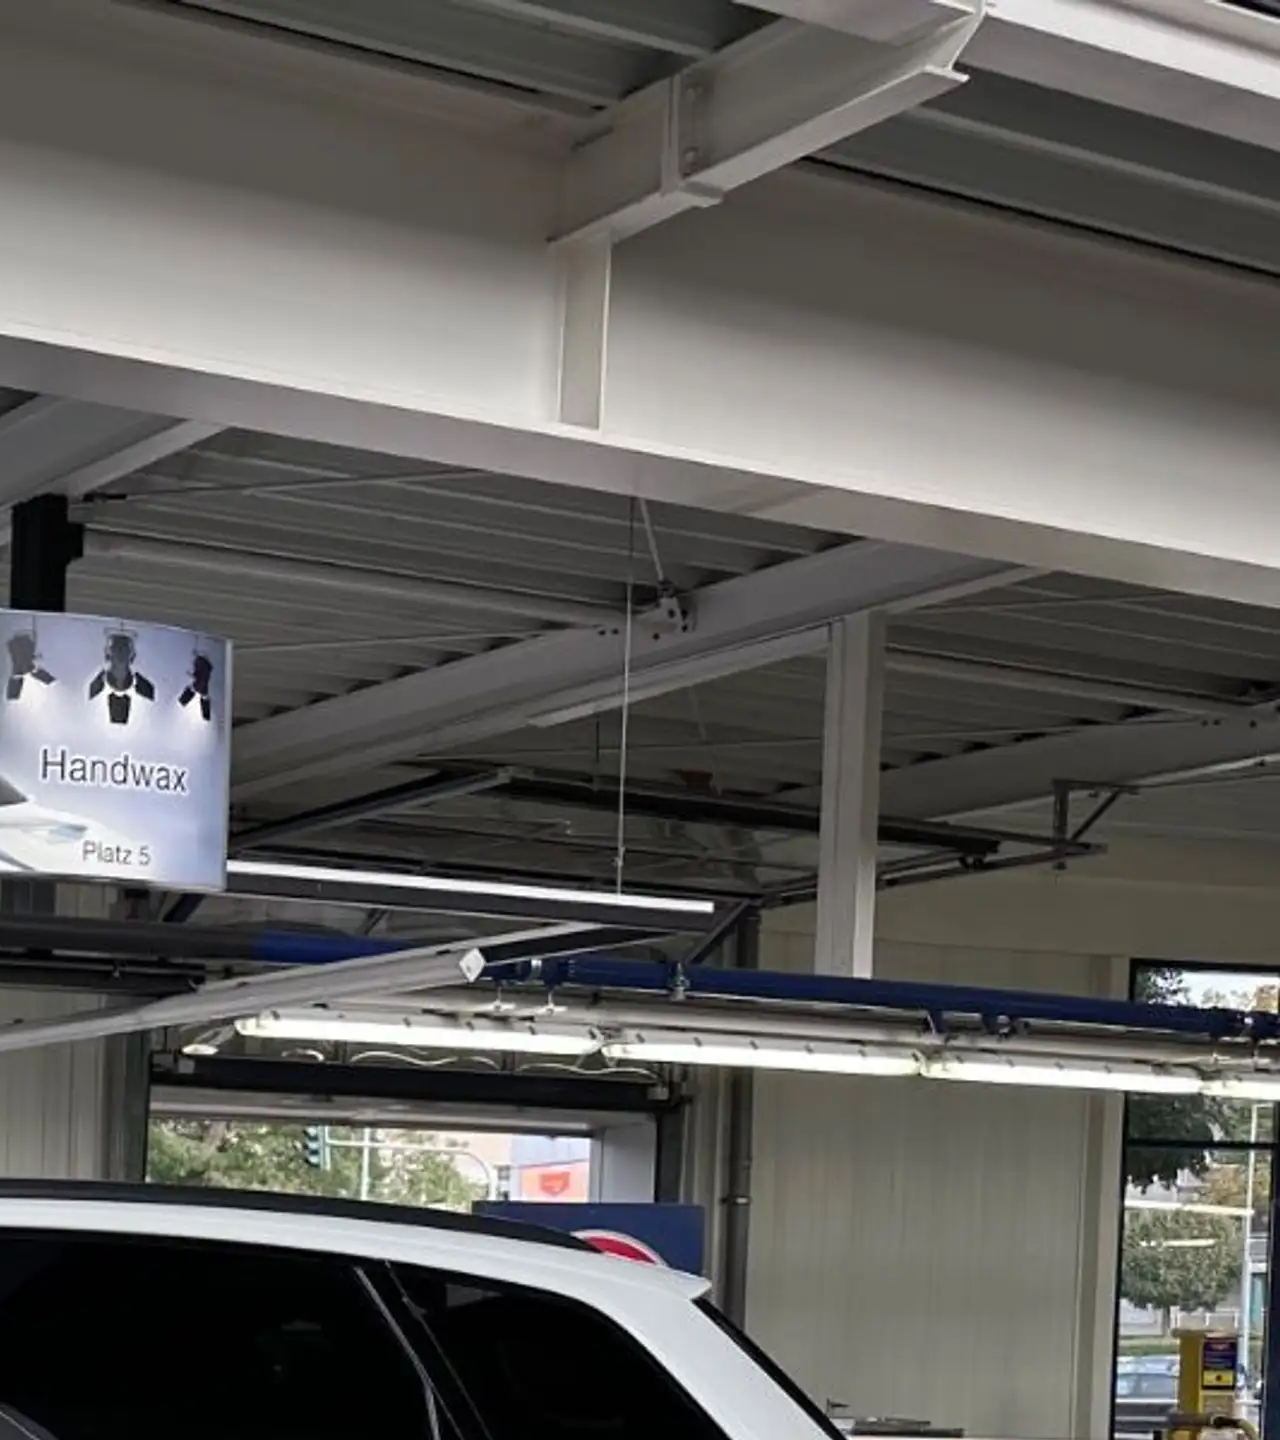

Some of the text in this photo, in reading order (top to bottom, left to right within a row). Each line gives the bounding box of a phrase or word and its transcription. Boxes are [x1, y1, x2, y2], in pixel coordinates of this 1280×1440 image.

[41, 748, 187, 792] Handwax
[82, 840, 151, 867] Platz 5
